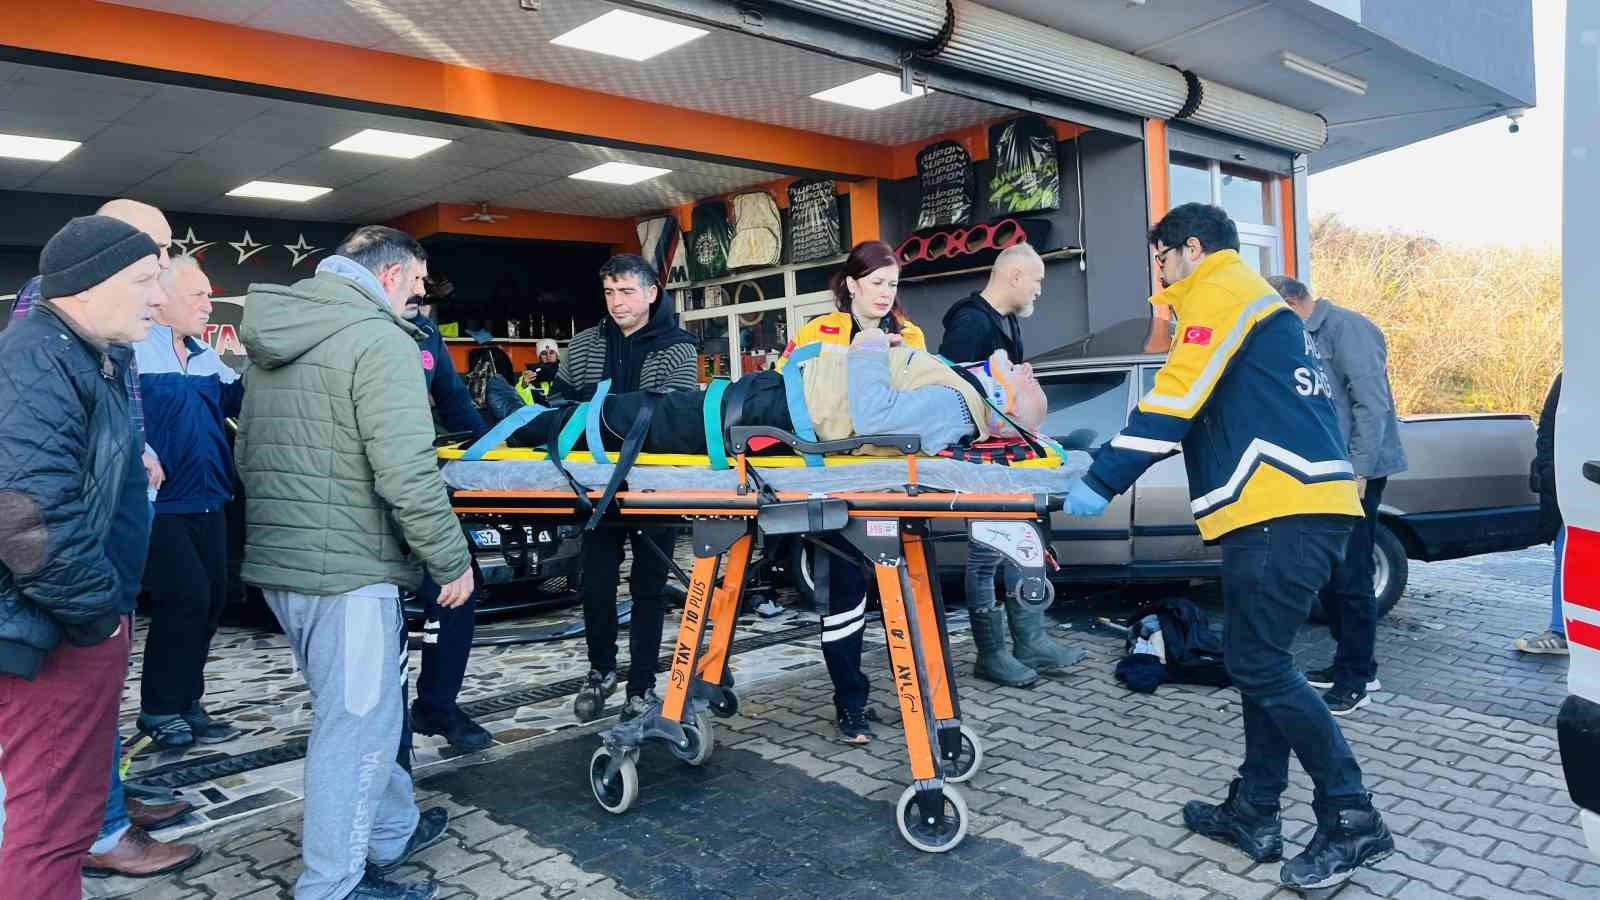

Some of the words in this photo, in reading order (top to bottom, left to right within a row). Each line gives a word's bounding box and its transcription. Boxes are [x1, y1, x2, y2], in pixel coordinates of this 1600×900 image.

[201, 323, 248, 356] TA
[676, 642, 691, 665] TAY
[689, 579, 705, 608] PLUS
